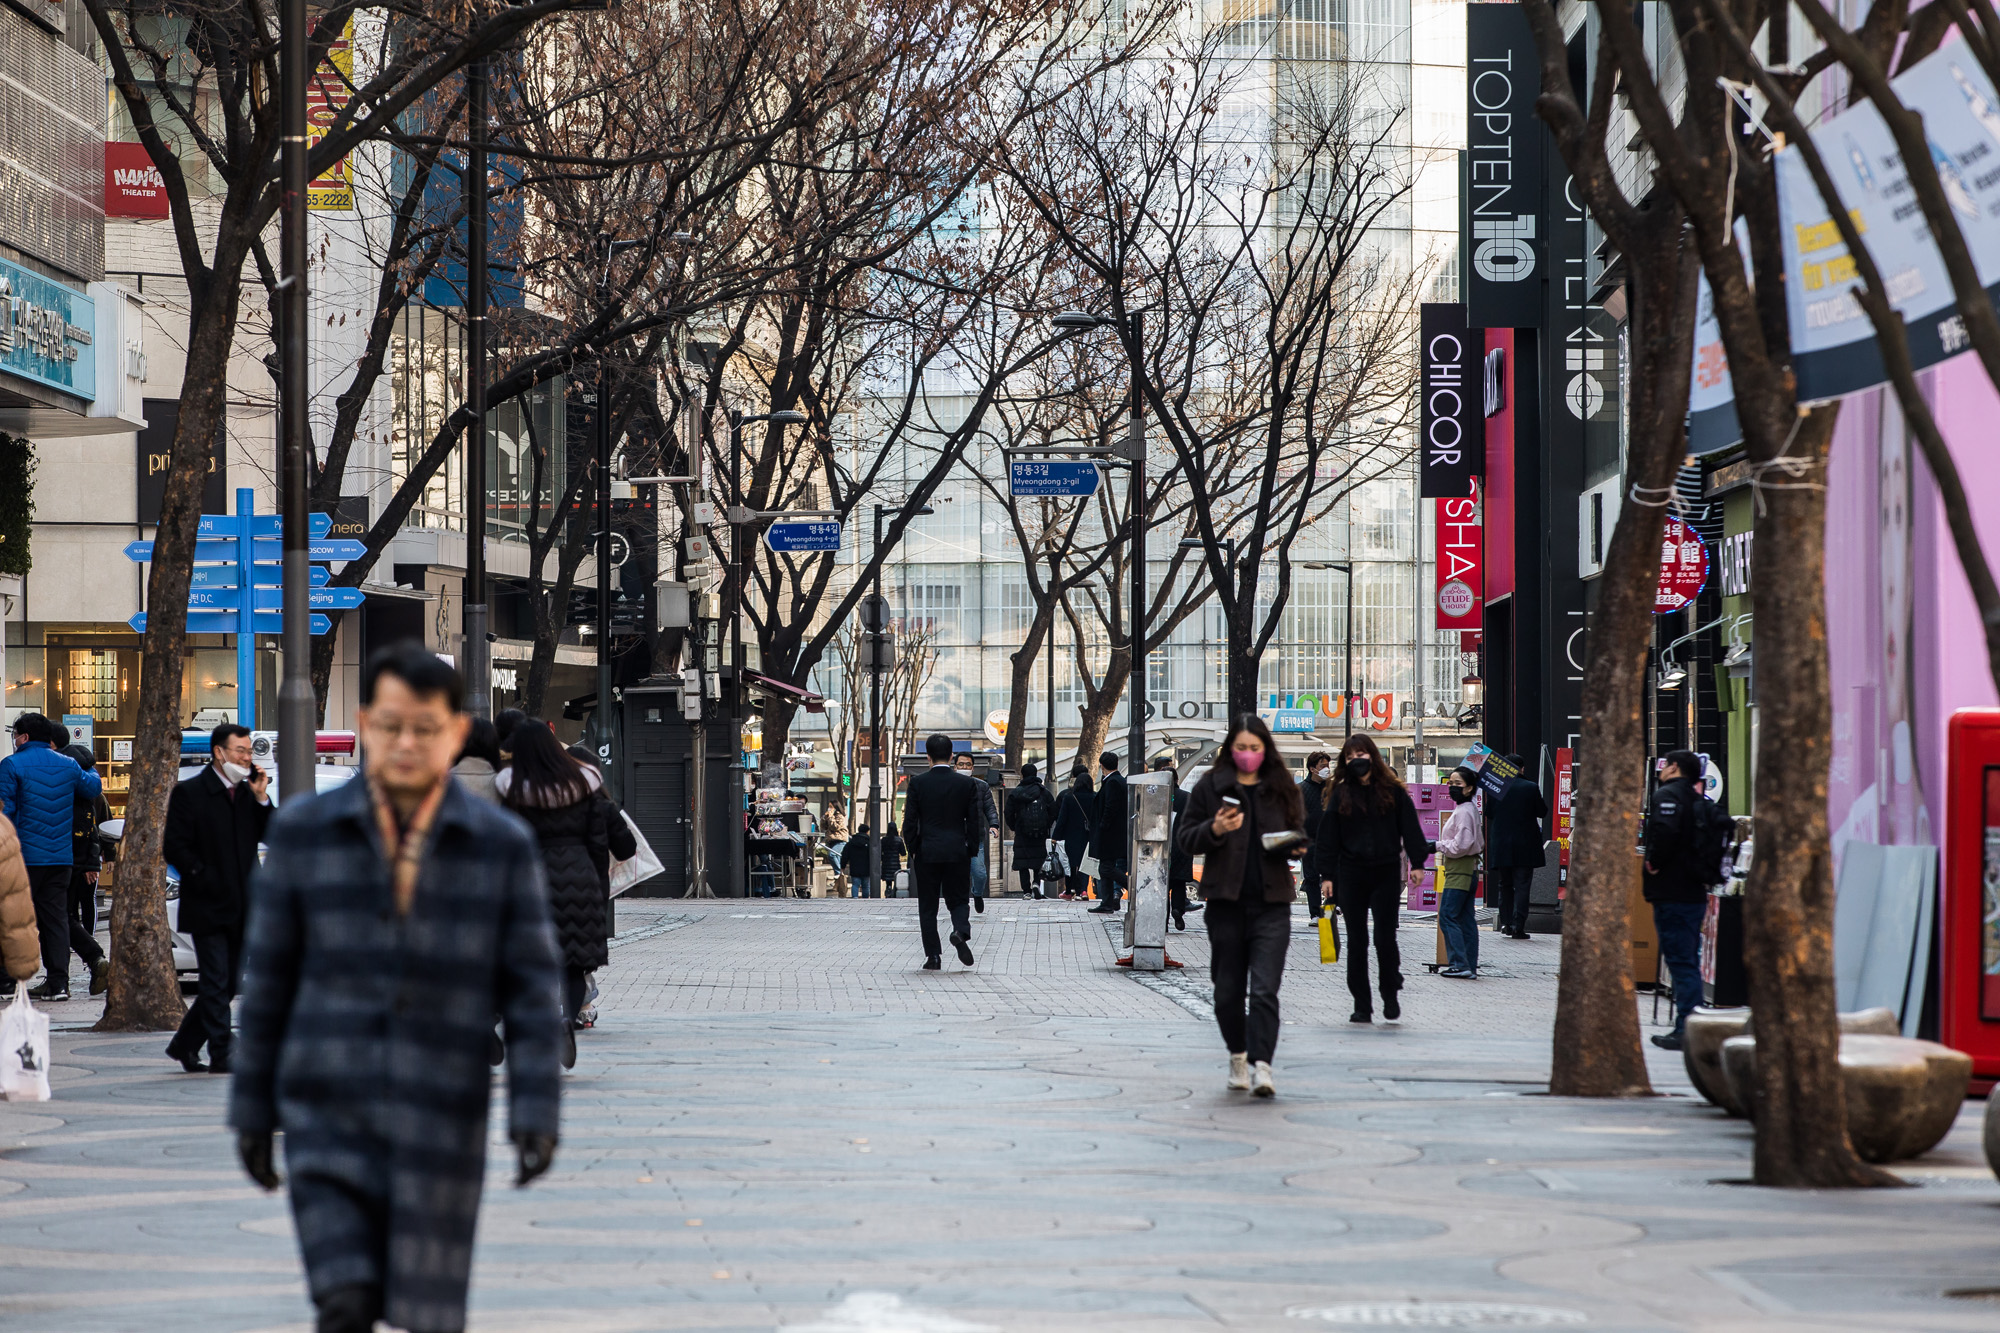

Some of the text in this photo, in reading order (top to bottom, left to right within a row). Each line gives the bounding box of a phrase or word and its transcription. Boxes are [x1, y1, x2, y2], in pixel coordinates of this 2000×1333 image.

[1473, 49, 1535, 282] TOPTEN 10
[114, 166, 165, 187] NANTA
[122, 189, 156, 197] THEATER
[1429, 333, 1462, 467] CHICOR
[1014, 465, 1049, 476] 명동3길
[1014, 478, 1080, 487] Myeongdong 3-gil
[198, 520, 213, 531] 시티
[809, 525, 838, 535] 명동4길
[1445, 478, 1476, 580] SHA
[200, 594, 214, 604] D.C.
[1441, 595, 1471, 604] ETUDE
